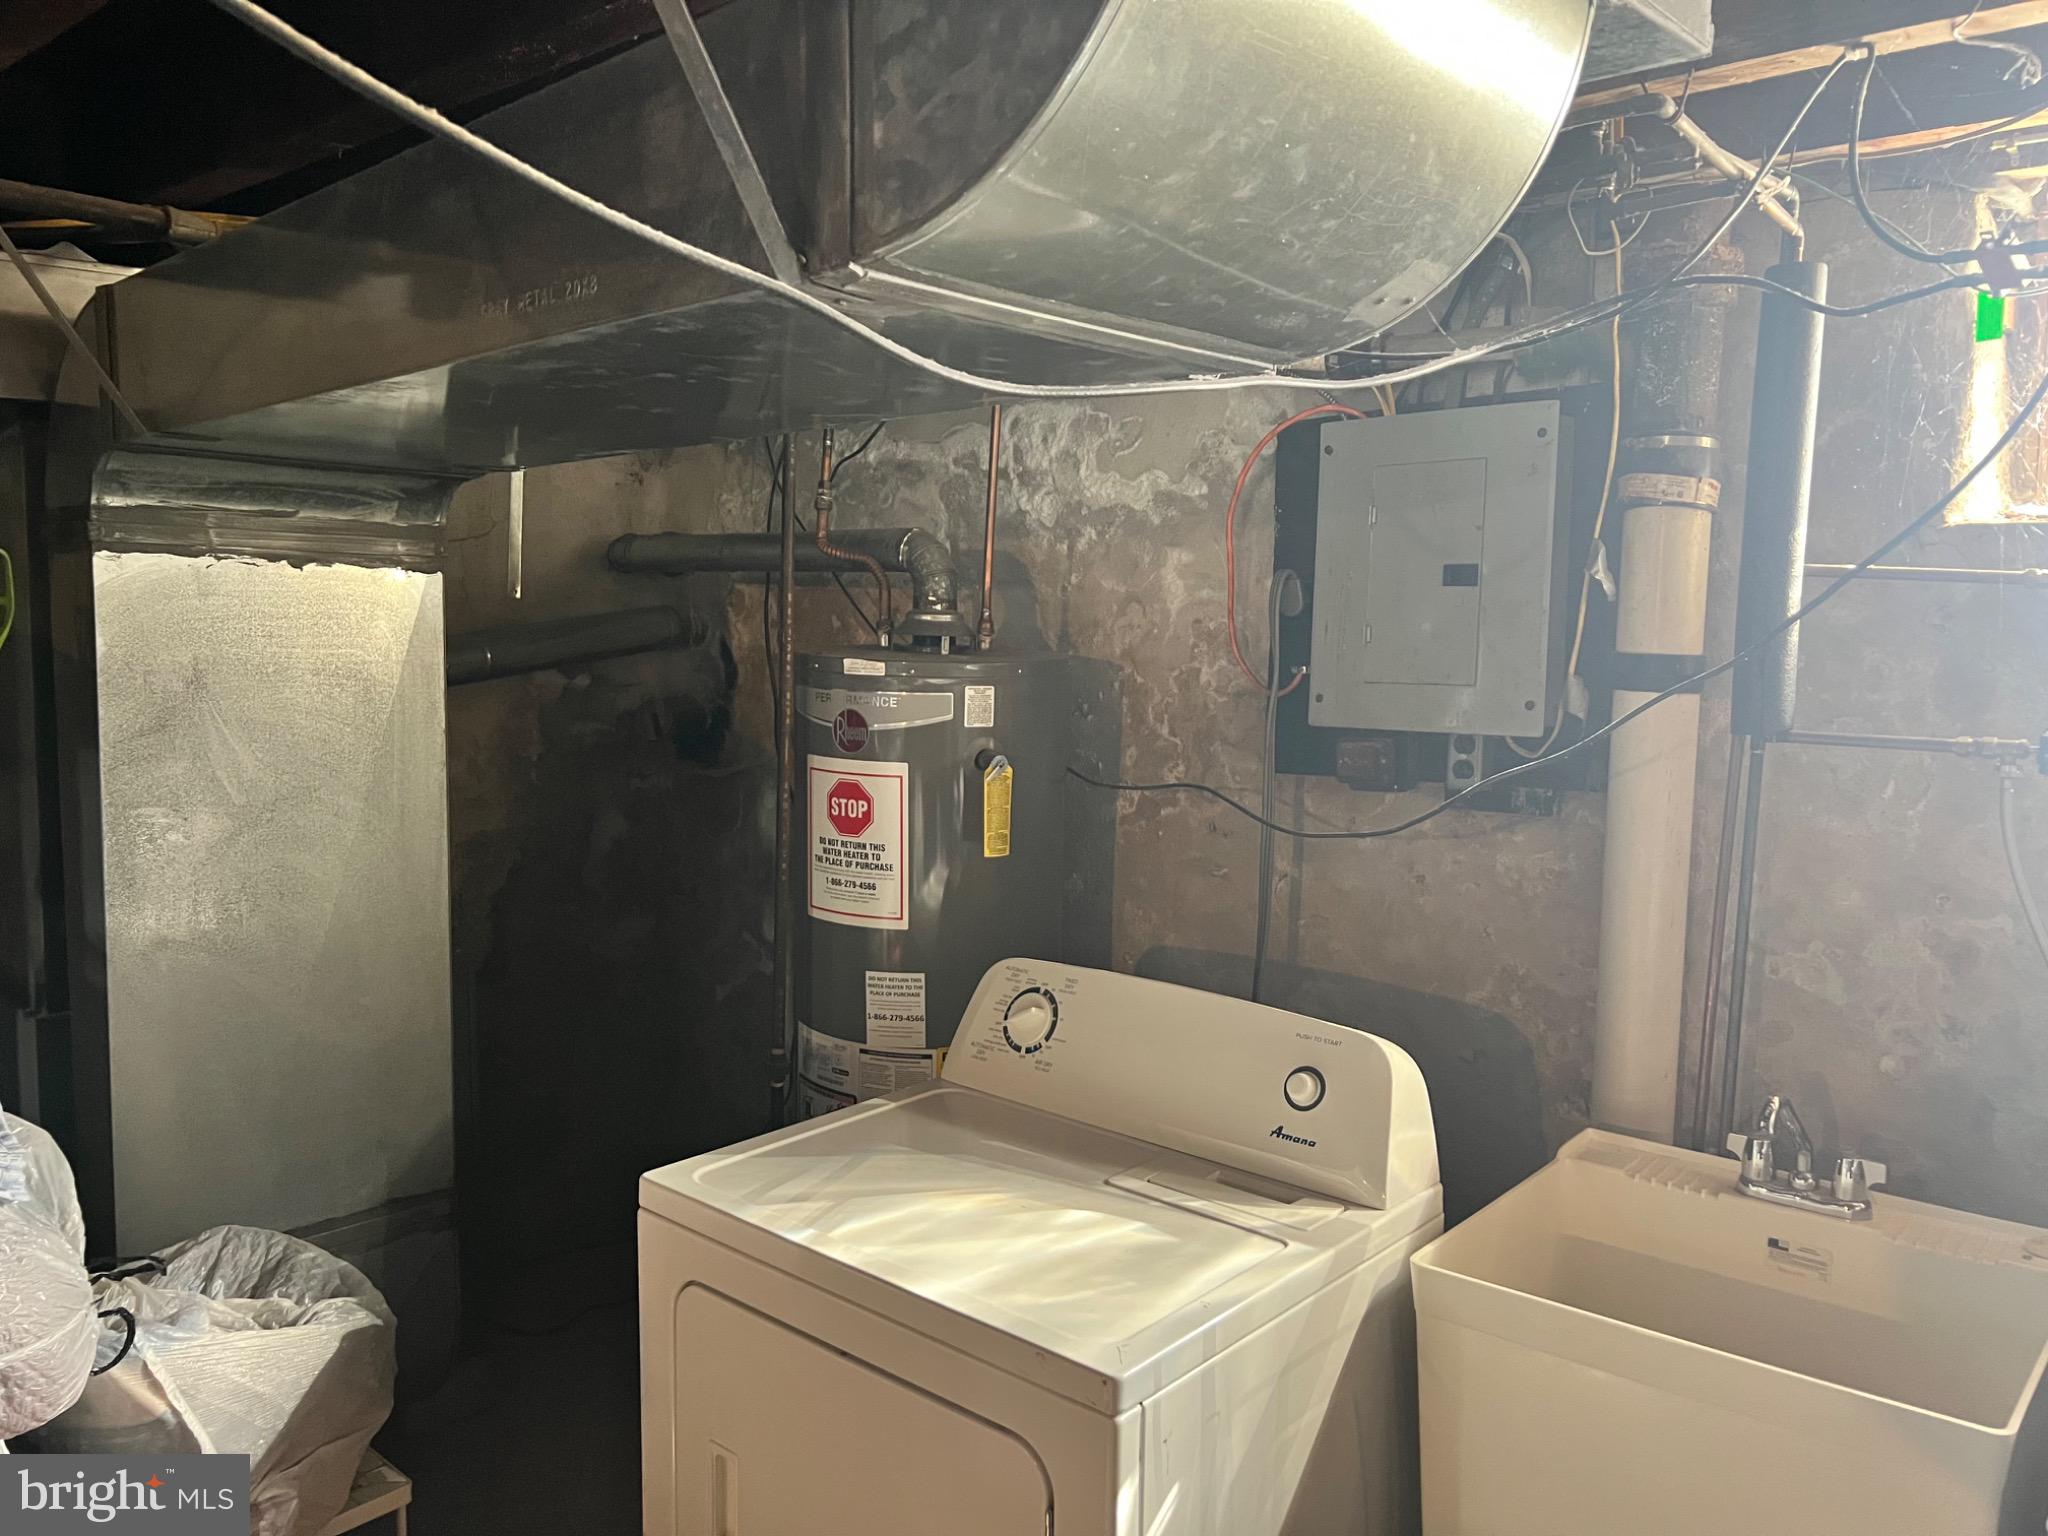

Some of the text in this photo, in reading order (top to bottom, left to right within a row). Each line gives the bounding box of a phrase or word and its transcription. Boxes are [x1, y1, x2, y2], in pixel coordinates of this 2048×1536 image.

[831, 798, 868, 819] STOP
[819, 836, 887, 853] DO NOT RETURN THIS
[822, 846, 882, 862] WATER HEATER TO
[814, 854, 825, 865] THE
[825, 855, 844, 868] PLACE
[844, 858, 854, 869] OF
[855, 860, 895, 873] PURCHASE
[825, 877, 877, 891] 1-866-279-4566
[868, 1012, 924, 1022] 1-866-279-4566
[1295, 1033, 1312, 1041] PUSH
[1323, 1039, 1343, 1047] START
[1270, 1125, 1317, 1148] Amana
